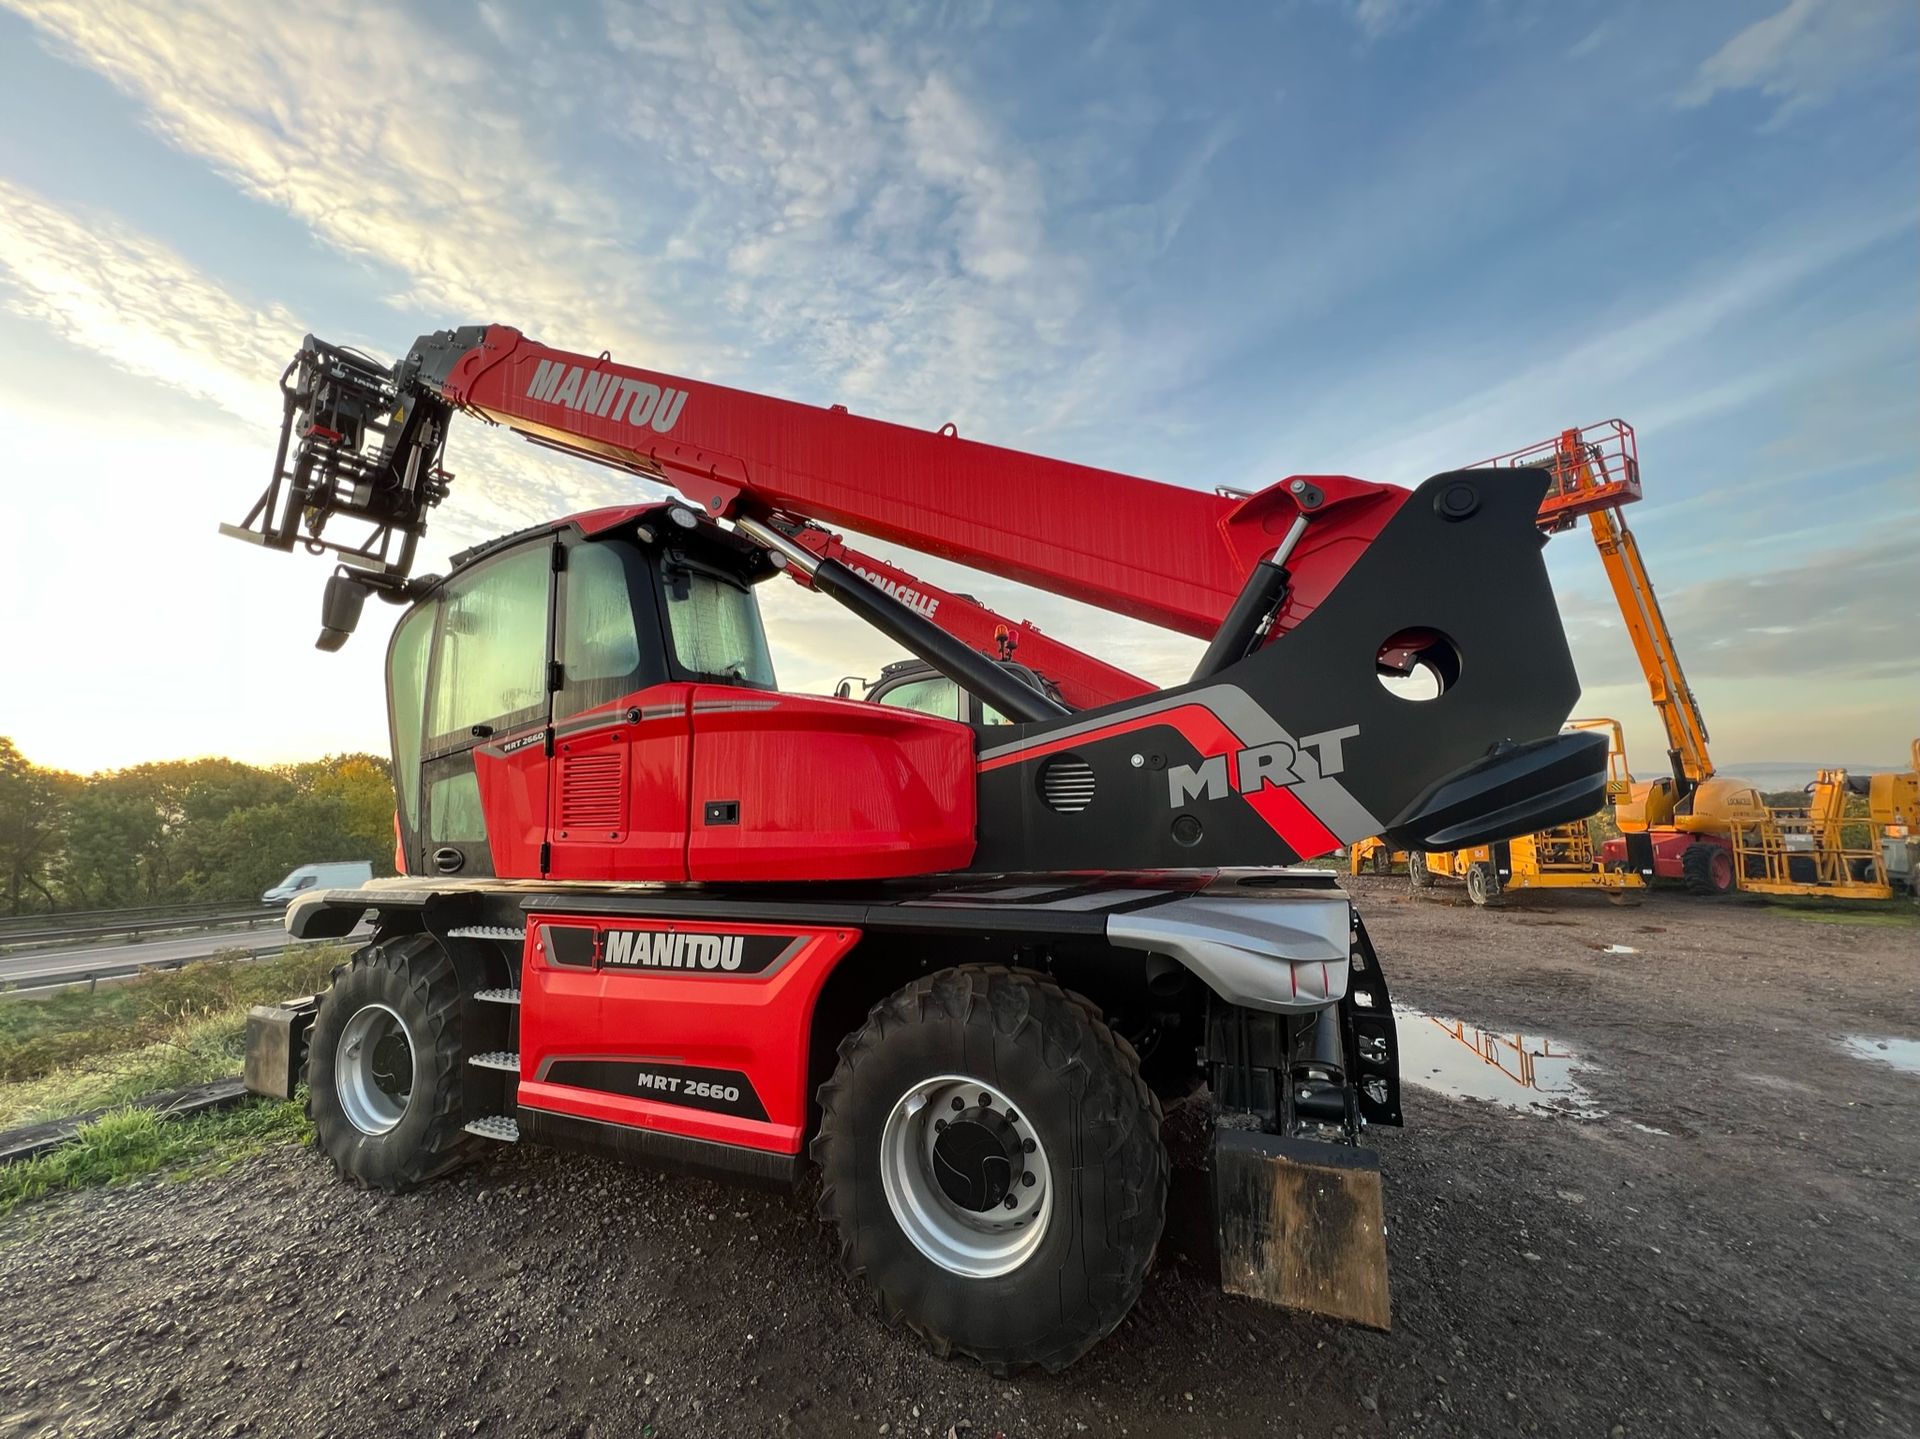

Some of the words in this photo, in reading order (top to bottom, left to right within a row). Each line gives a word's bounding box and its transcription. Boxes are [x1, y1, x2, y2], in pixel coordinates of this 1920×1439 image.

[526, 359, 689, 433] MANITOU
[504, 739, 521, 752] MRT
[522, 732, 544, 745] 2660
[1168, 724, 1360, 809] MRT
[605, 931, 744, 971] MANITOU
[638, 1073, 681, 1092] MRT
[683, 1080, 740, 1102] 2660
